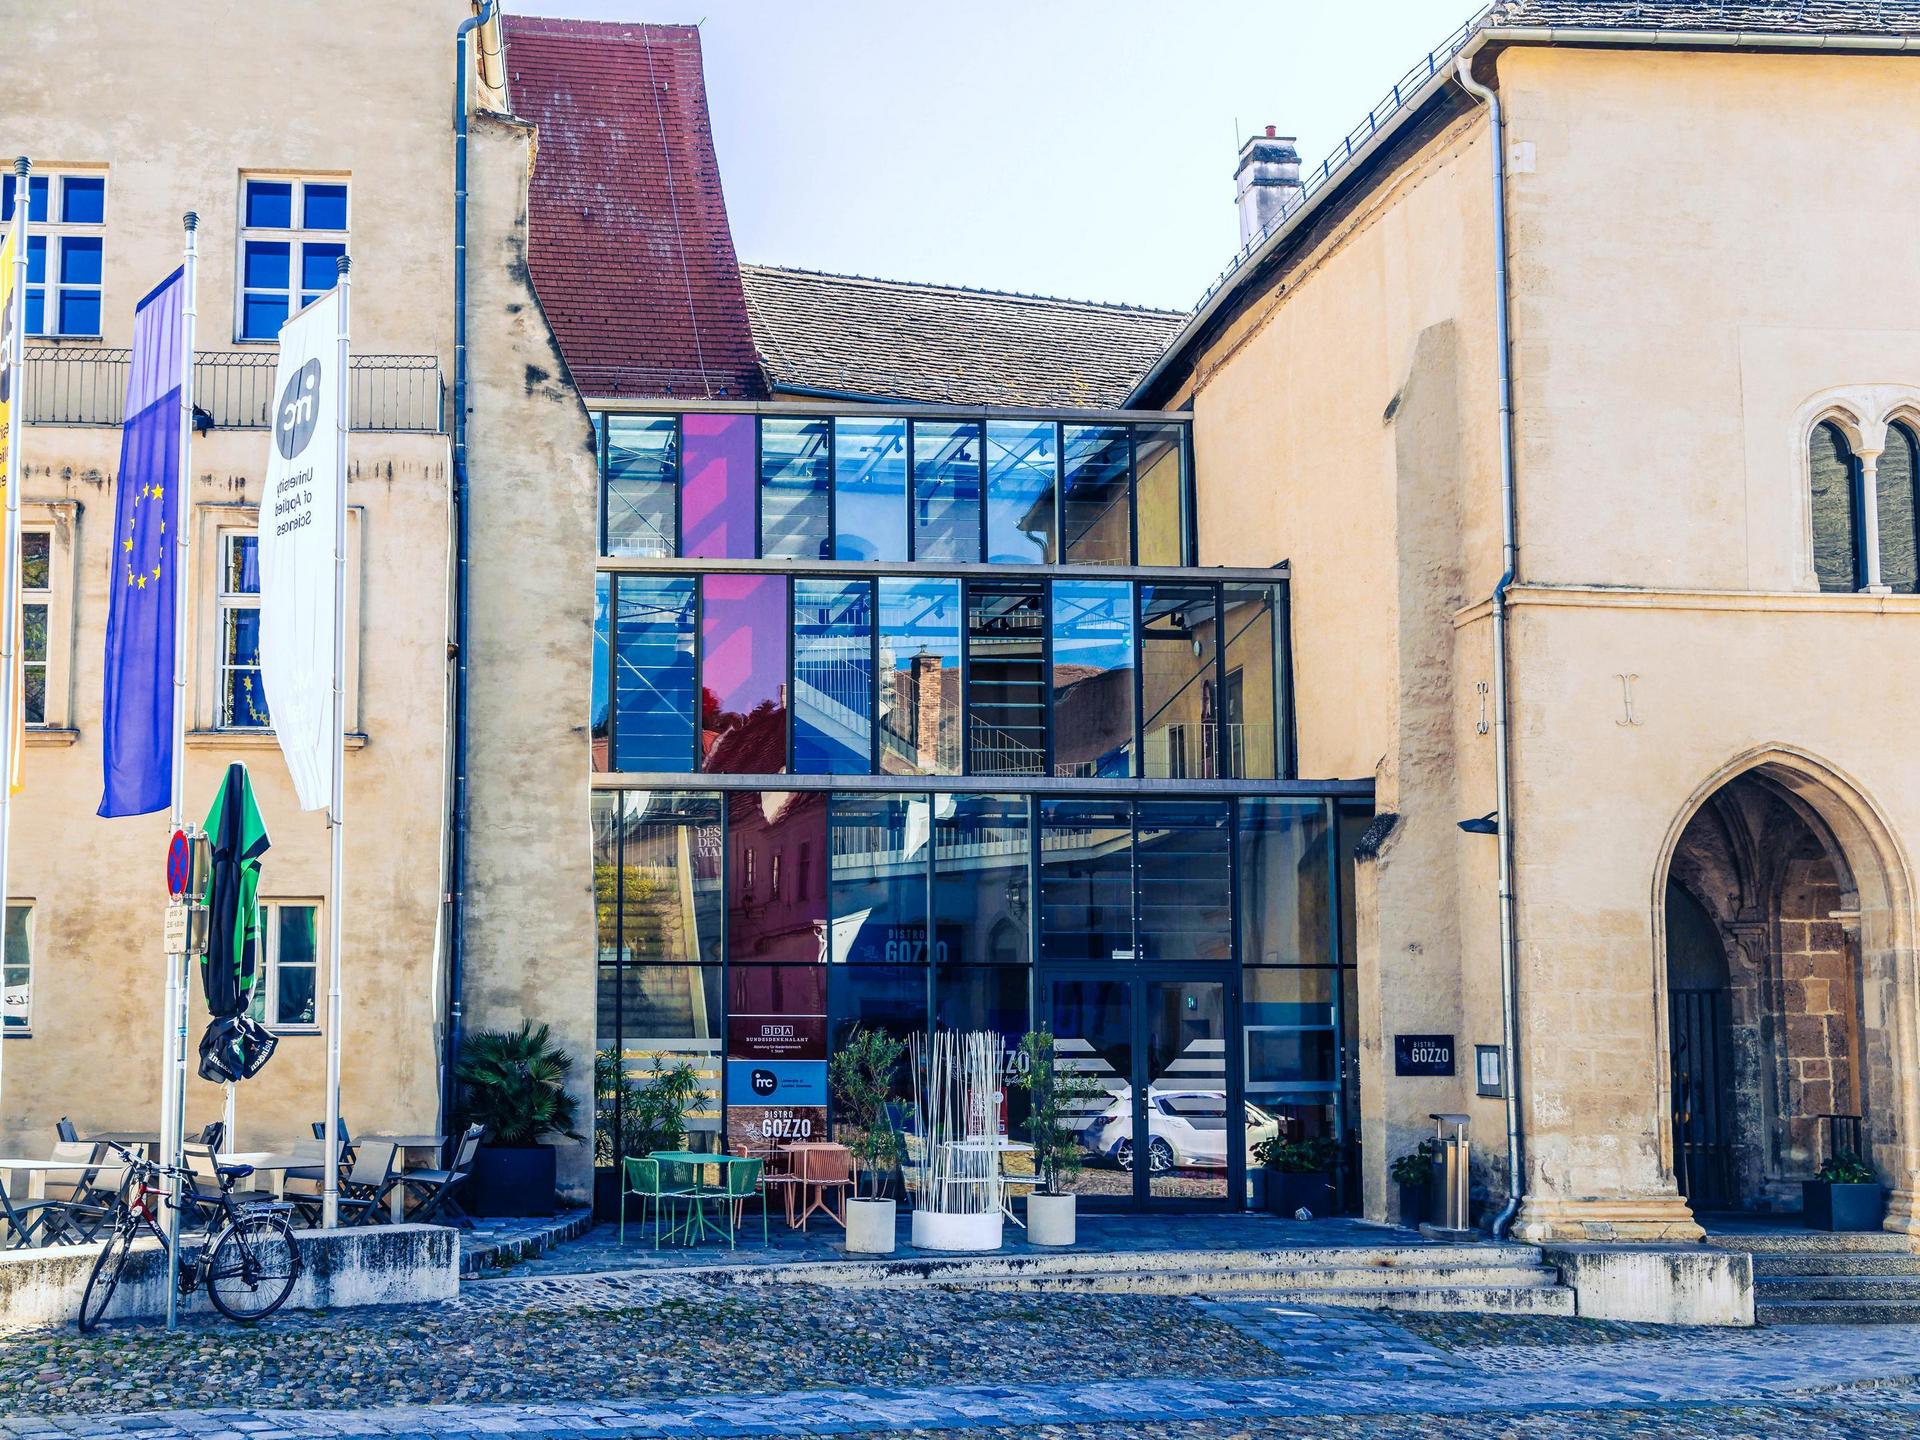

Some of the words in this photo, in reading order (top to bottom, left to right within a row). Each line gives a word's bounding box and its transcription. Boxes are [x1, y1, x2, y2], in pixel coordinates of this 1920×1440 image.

[763, 1026, 793, 1036] BDA
[1411, 1048, 1449, 1063] GOZZO
[764, 1110, 794, 1118] BISTRO
[762, 1118, 811, 1138] GOZZO
